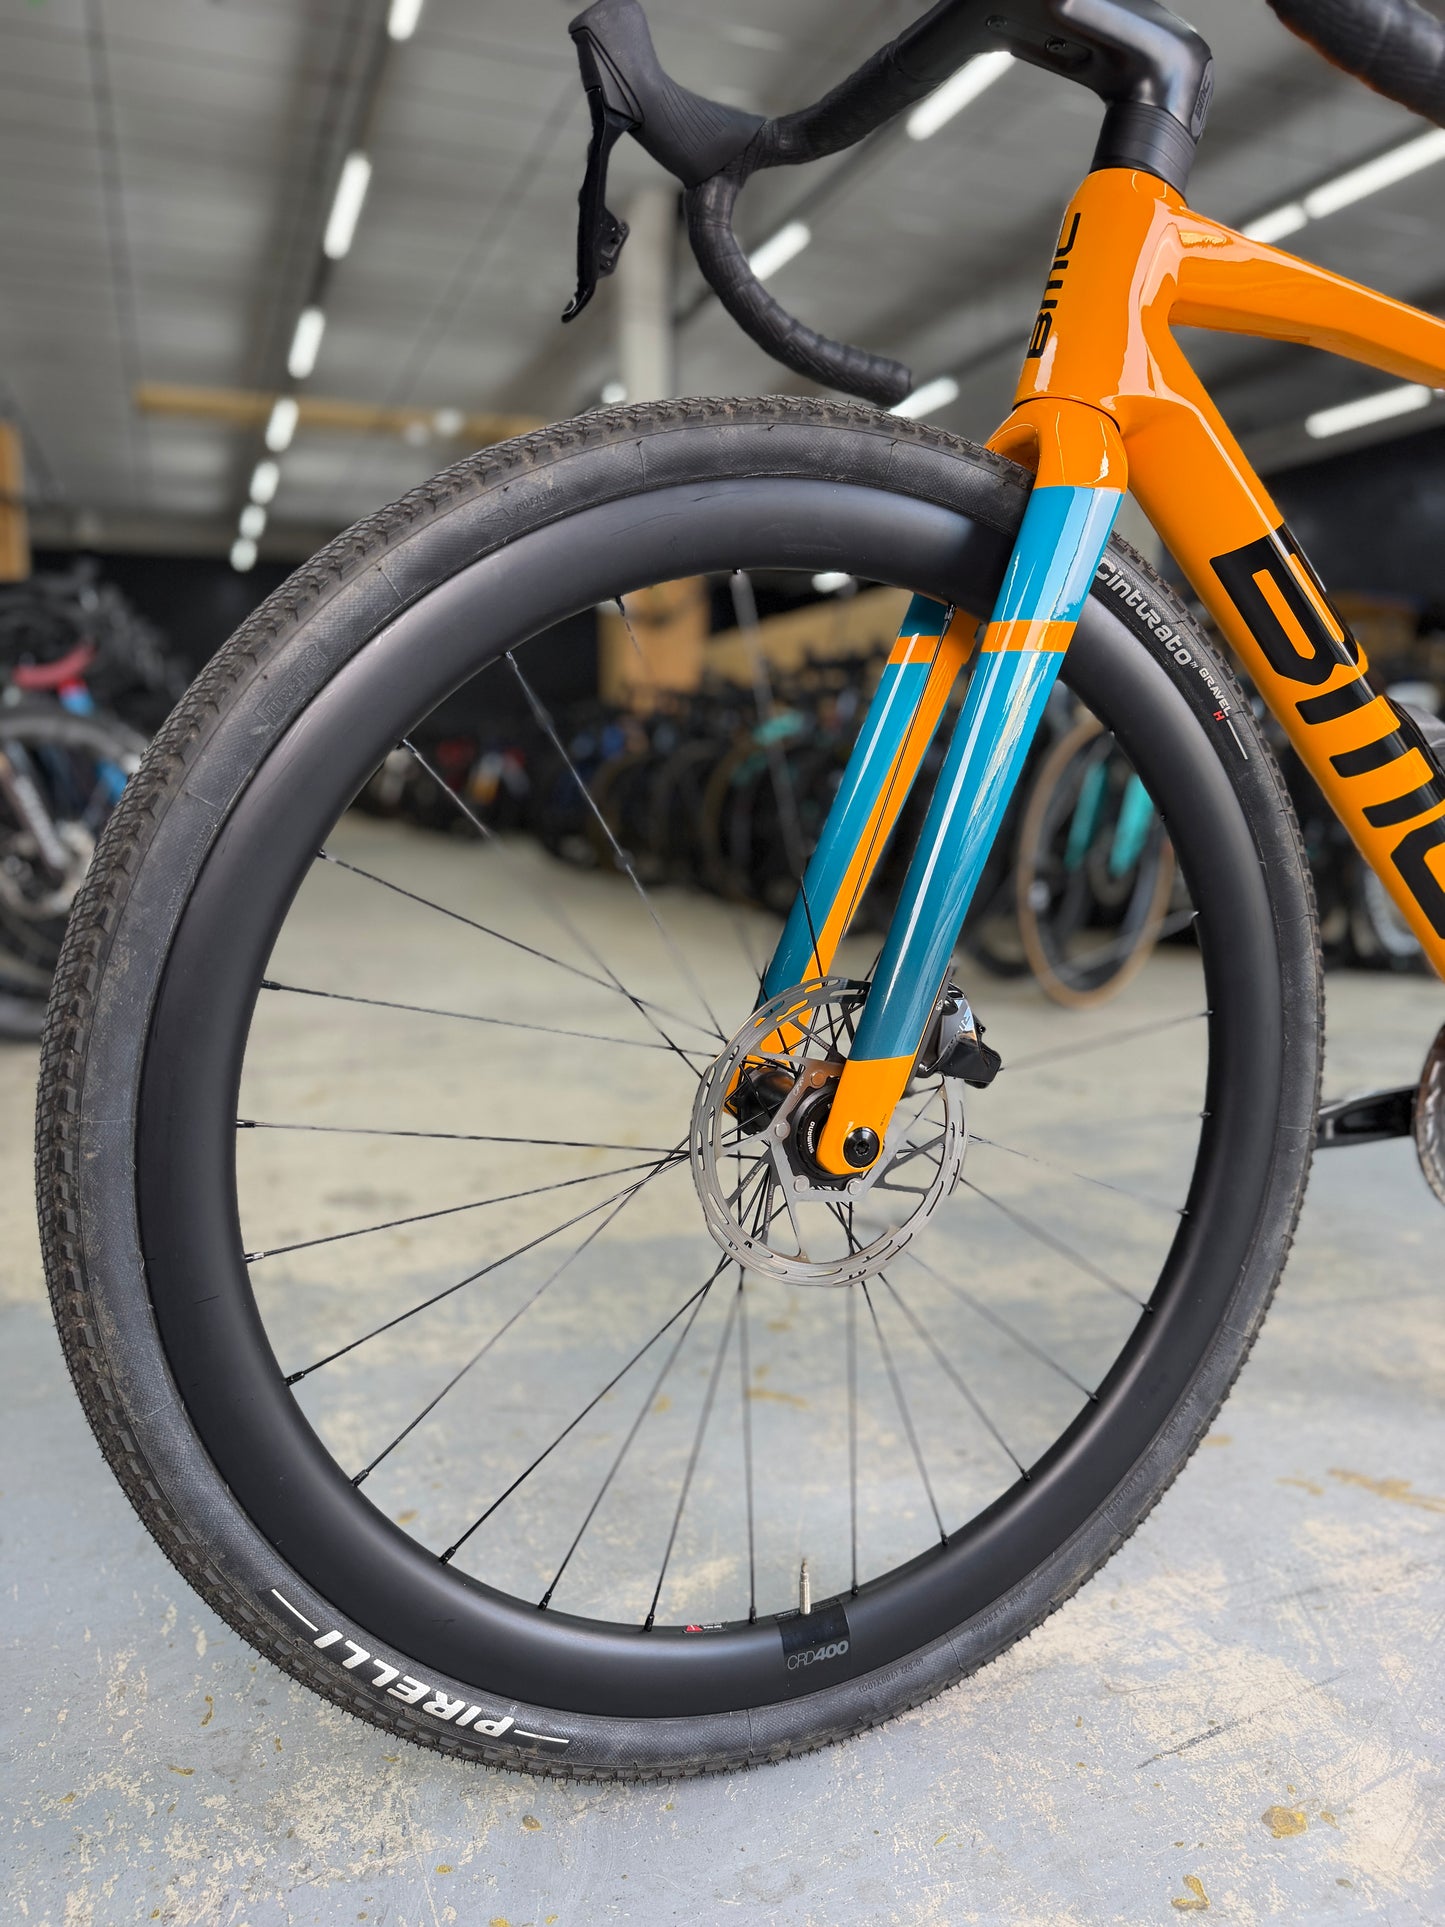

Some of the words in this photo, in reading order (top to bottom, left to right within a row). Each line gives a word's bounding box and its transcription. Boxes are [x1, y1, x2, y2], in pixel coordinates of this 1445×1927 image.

[1026, 213, 1081, 359] BMC
[1095, 557, 1192, 666] Cinturato
[1199, 668, 1232, 717] GRAVEL
[1213, 711, 1225, 721] H
[807, 1121, 816, 1154] SHIMANO
[314, 1630, 514, 1737] PIRELLI
[787, 1640, 849, 1670] CRD400
